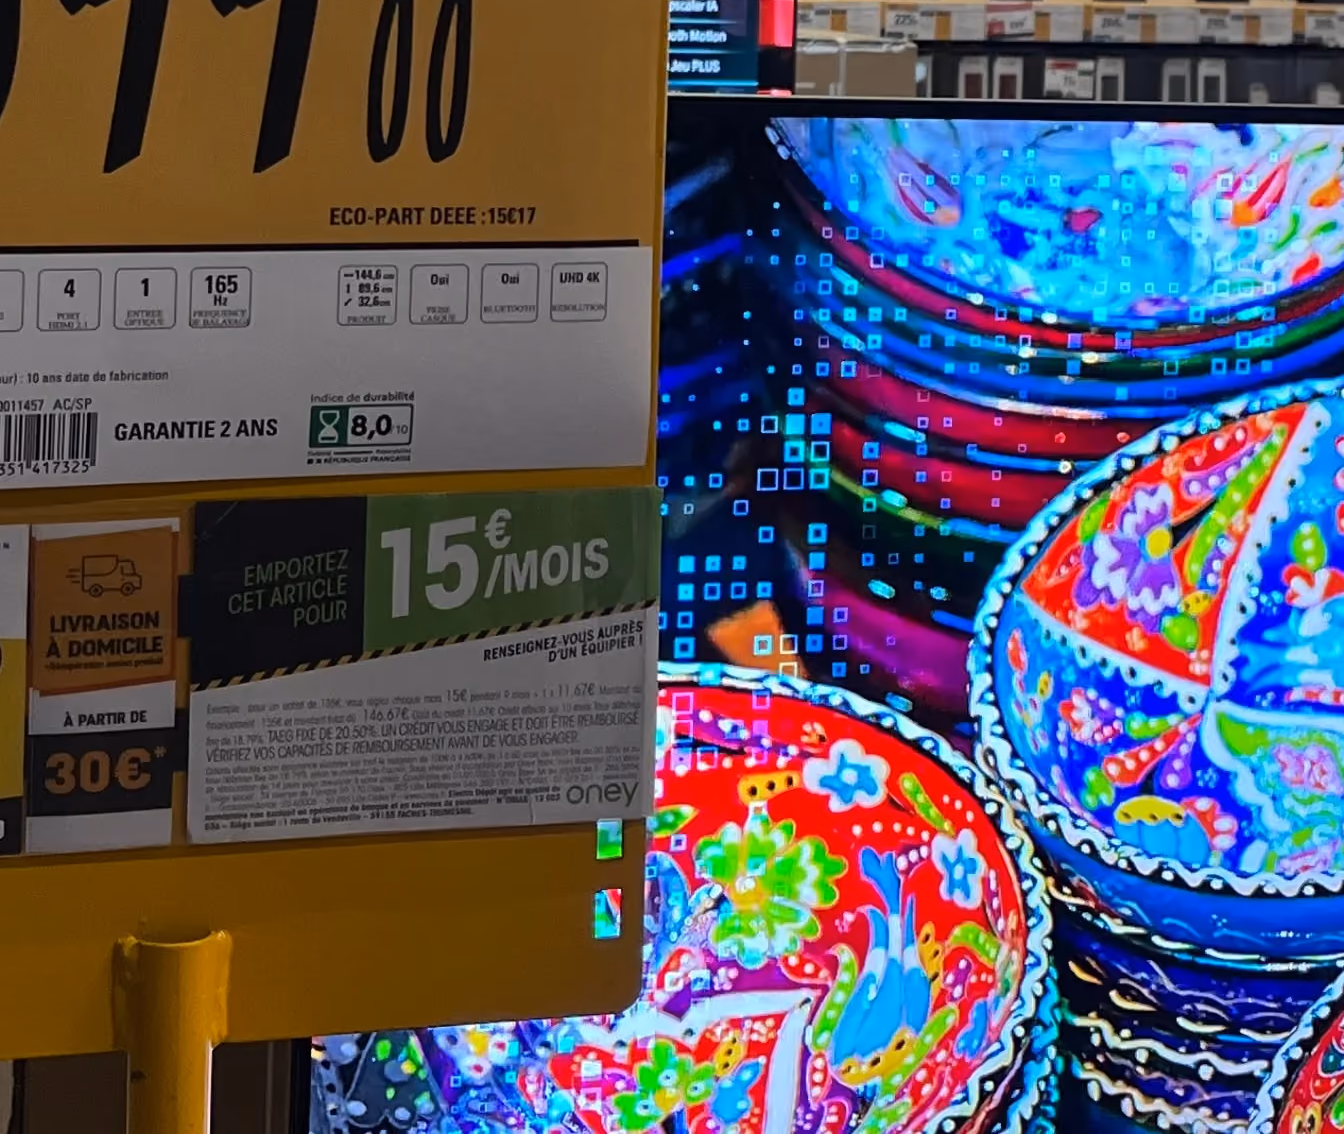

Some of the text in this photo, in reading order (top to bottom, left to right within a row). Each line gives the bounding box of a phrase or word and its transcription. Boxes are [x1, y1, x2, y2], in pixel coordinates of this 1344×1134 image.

[329, 207, 425, 226] ECO-PART
[430, 206, 476, 226] DEEE
[63, 278, 76, 298] 4
[141, 277, 150, 297] 1
[205, 274, 238, 294] 165
[430, 273, 449, 286] Oui
[501, 272, 520, 286] Oui
[559, 271, 600, 284] UHD 4K
[213, 294, 228, 307] Hz
[27, 372, 40, 384] 10
[42, 374, 62, 384] ans
[65, 371, 89, 383] date
[93, 370, 106, 383] de
[109, 370, 169, 382] fabrication
[53, 397, 93, 411] AC/SP
[310, 390, 415, 404] Indice de durabilité
[114, 418, 278, 441] GARANTIE 2 ANS
[350, 414, 392, 440] 8,0
[32, 460, 89, 475] 417325
[244, 549, 349, 587] EMPORTEZ
[380, 507, 609, 619] 15 € /MOIS
[228, 574, 347, 615] CET ARTICLE
[50, 611, 160, 633] LIVRAISON
[293, 599, 347, 627] POUR
[45, 635, 163, 659] À DOMICILE
[483, 619, 644, 662] RENSEIGNEZ-VOUS AUPRÈS
[548, 633, 637, 663] D'UN ÉQUIPIER
[63, 710, 147, 727] À PARTIR DE
[320, 726, 334, 741] DE
[381, 723, 398, 737] UN
[399, 719, 436, 737] CRÉDIT
[437, 719, 466, 735] VOUS
[467, 718, 509, 733] ENGAGE
[511, 716, 525, 731] ET
[526, 715, 550, 730] DOIT
[254, 745, 276, 761] VOS
[336, 740, 350, 756] DE
[448, 735, 480, 750] AVANT
[482, 734, 497, 749] DE
[499, 733, 528, 748] VOUS
[566, 781, 640, 808] oney
